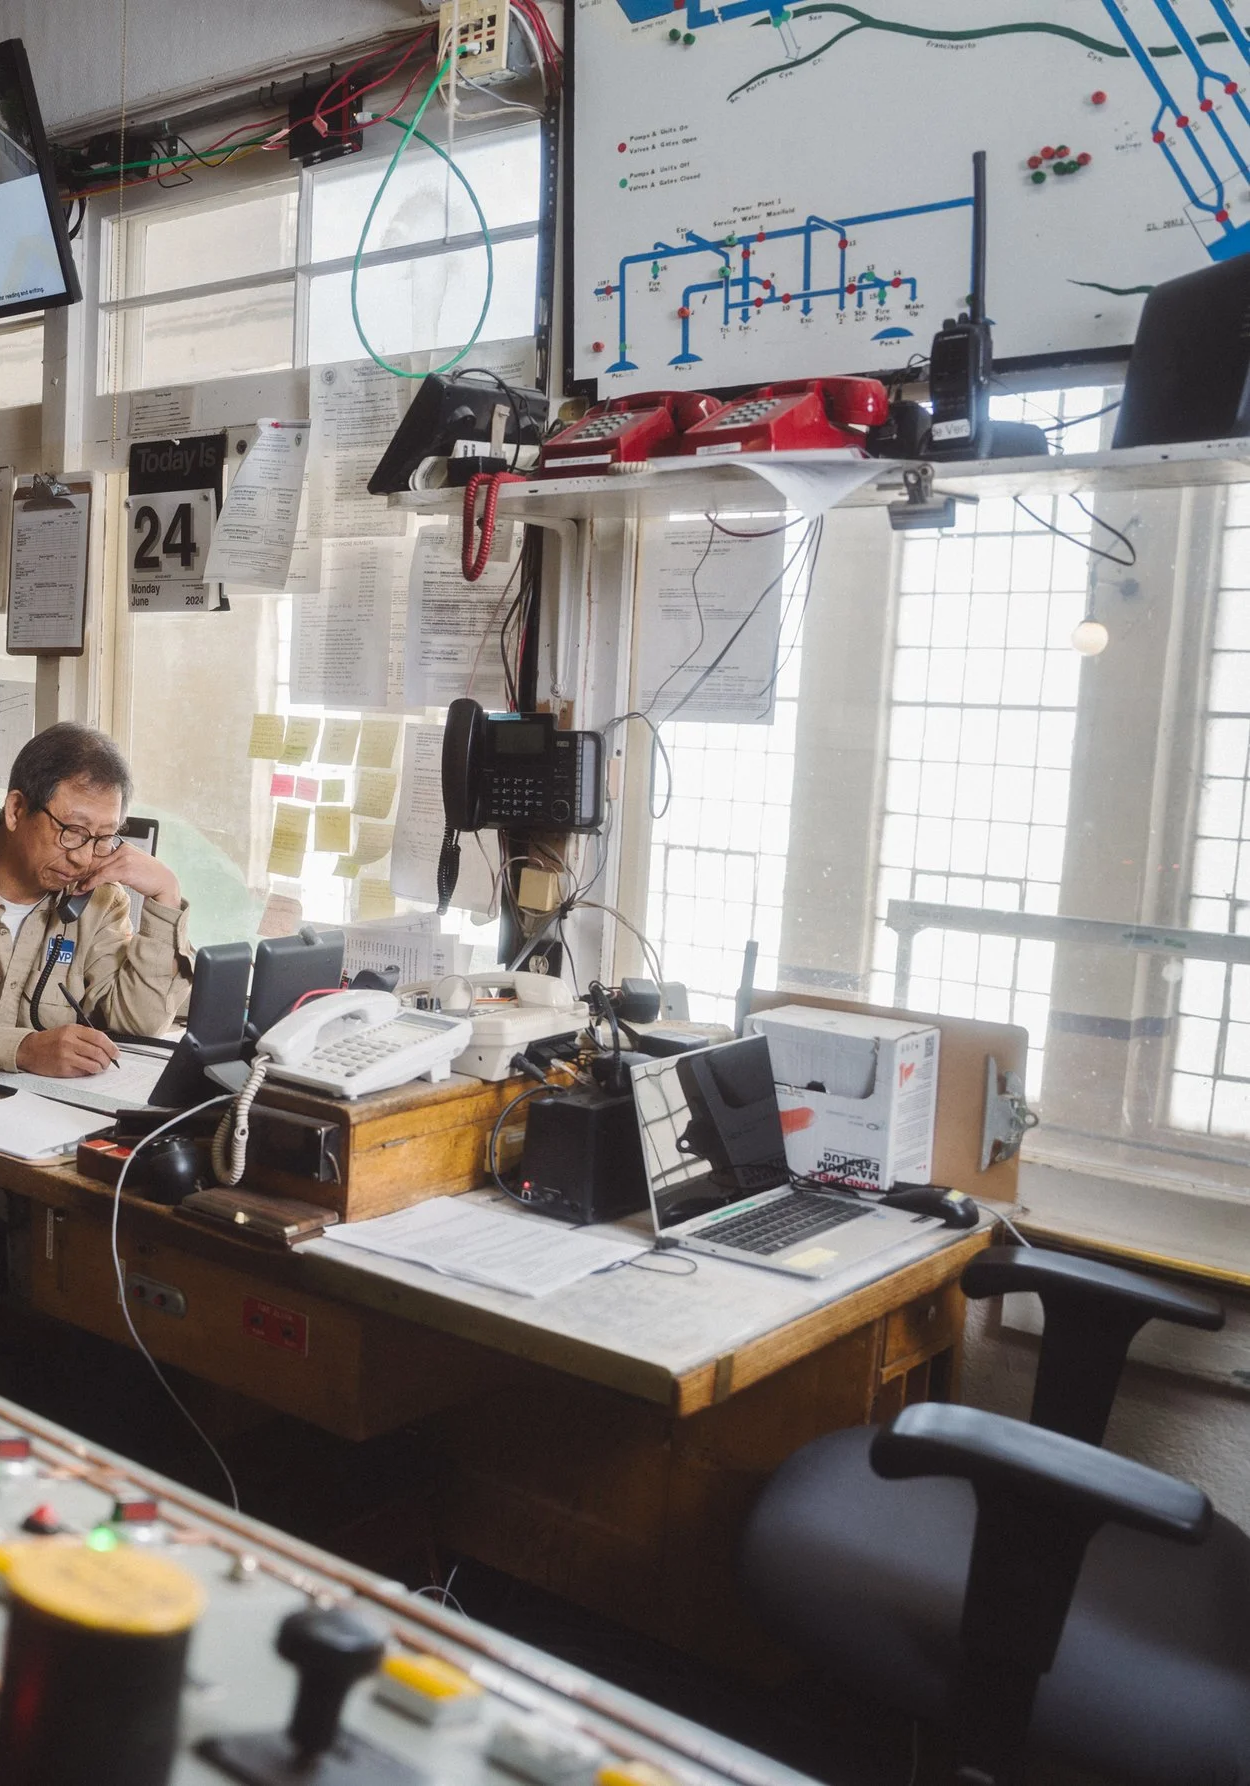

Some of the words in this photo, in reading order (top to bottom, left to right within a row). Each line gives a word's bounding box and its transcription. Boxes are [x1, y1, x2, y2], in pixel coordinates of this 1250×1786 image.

[926, 39, 977, 51] Francisquito
[629, 133, 649, 142] Pumps
[660, 127, 676, 135] Units
[629, 146, 649, 154] Valves
[660, 139, 679, 148] Gates
[681, 136, 697, 145] Open
[629, 171, 649, 179] Pumps
[659, 165, 677, 173] Units
[628, 183, 648, 192] Valves
[659, 178, 678, 186] Gates
[679, 173, 701, 182] Closed
[733, 204, 752, 213] Power
[757, 199, 775, 208] Plant
[713, 218, 736, 228] Service
[741, 213, 761, 222] Water
[766, 207, 795, 218] Manifold
[5, 292, 20, 301] reading
[20, 289, 29, 297] and
[137, 447, 194, 475] Today
[200, 441, 216, 468] Is
[133, 503, 198, 571] 24
[131, 583, 161, 595] Monday
[131, 596, 149, 607] June
[185, 595, 204, 606] 2024
[817, 1160, 879, 1181] MAXIMUM
